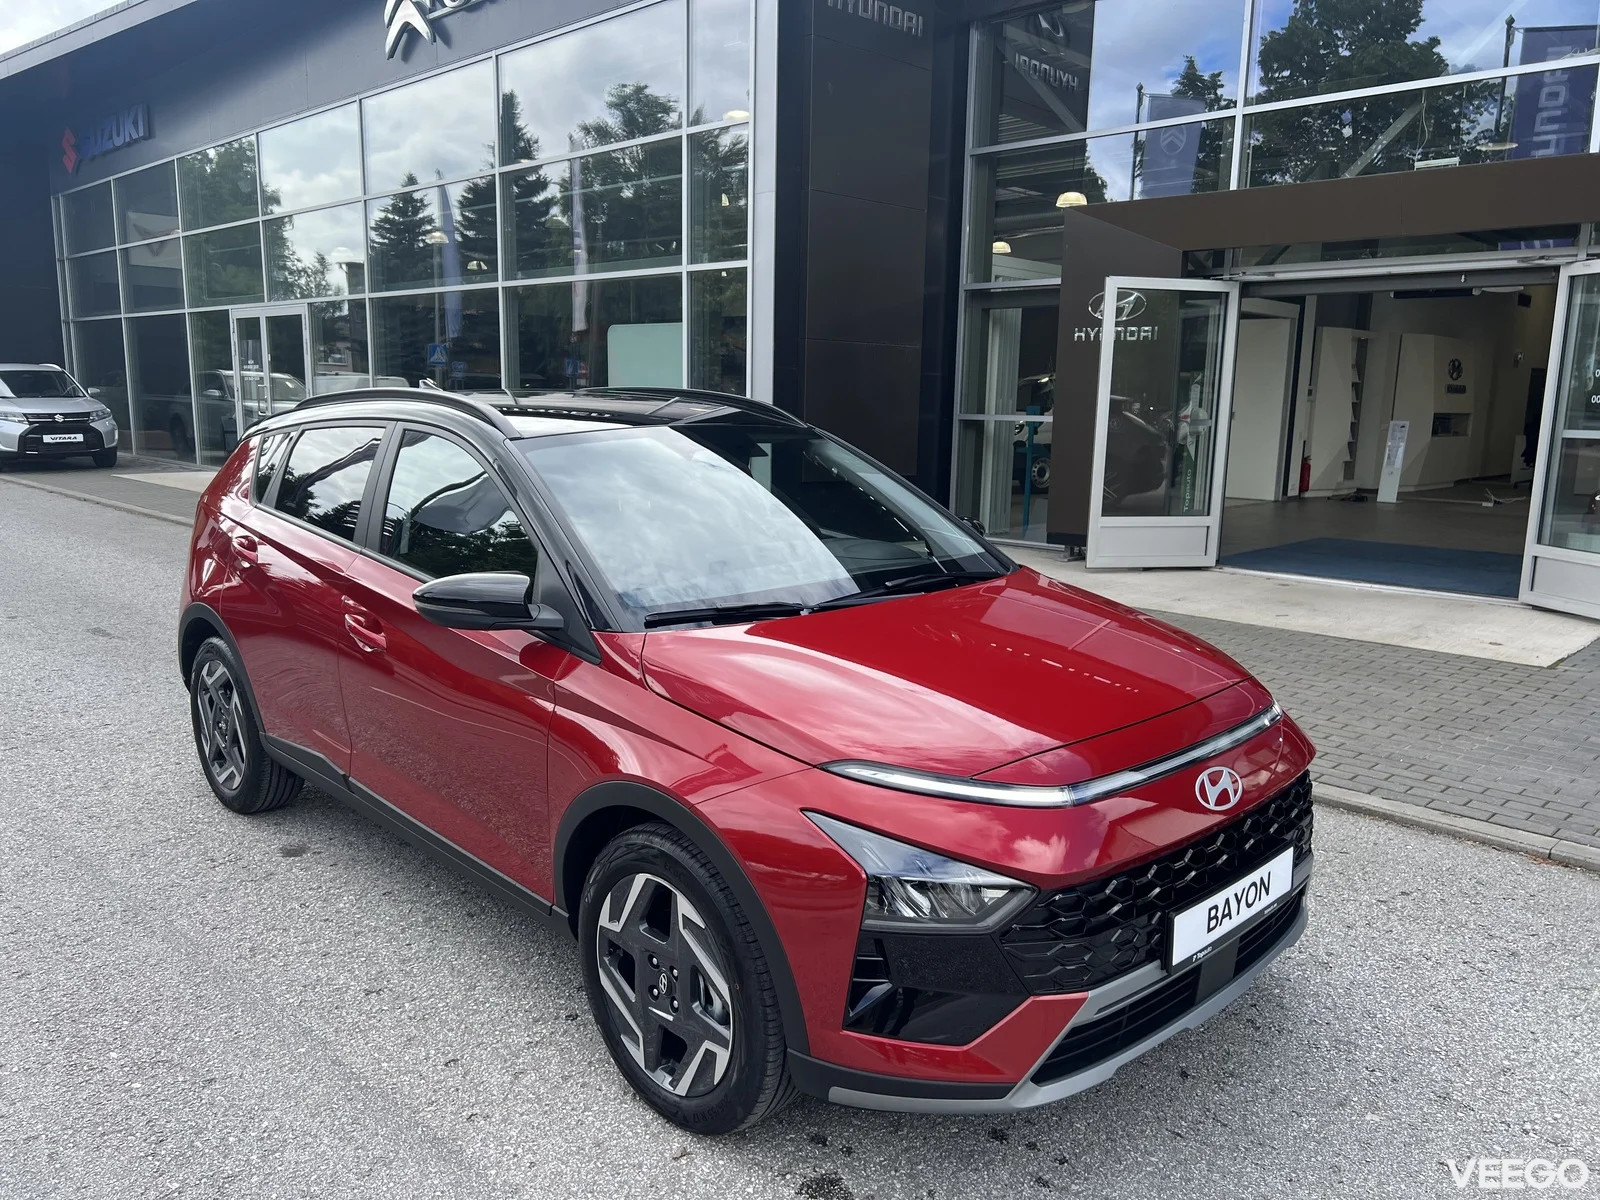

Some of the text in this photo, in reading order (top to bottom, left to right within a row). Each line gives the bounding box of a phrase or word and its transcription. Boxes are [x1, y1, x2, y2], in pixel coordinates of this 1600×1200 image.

[80, 104, 147, 160] SUZUKI
[1074, 326, 1158, 341] HYNDAI
[1183, 469, 1192, 512] Topauto
[1207, 871, 1271, 934] BAYON
